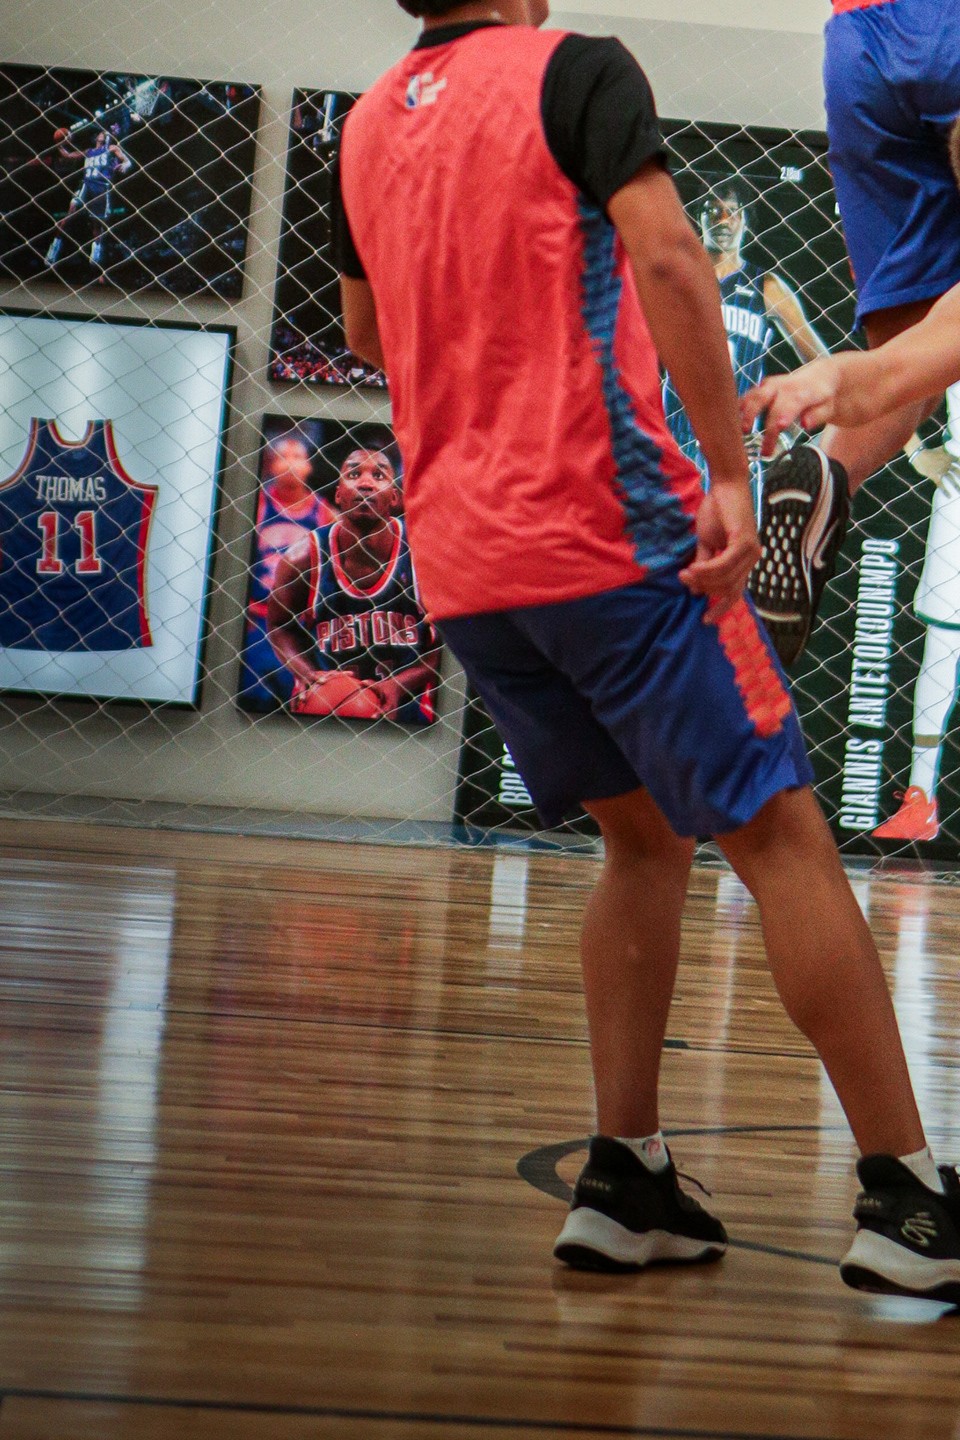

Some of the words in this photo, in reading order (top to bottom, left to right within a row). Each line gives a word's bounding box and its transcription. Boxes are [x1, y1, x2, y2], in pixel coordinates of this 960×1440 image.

[721, 304, 763, 343] NDO
[35, 474, 107, 502] THOMAS
[35, 510, 102, 574] 11
[316, 610, 419, 653] PISTONS
[847, 538, 900, 728] ANTETOKOUNMPO
[839, 738, 884, 830] GIANNIS
